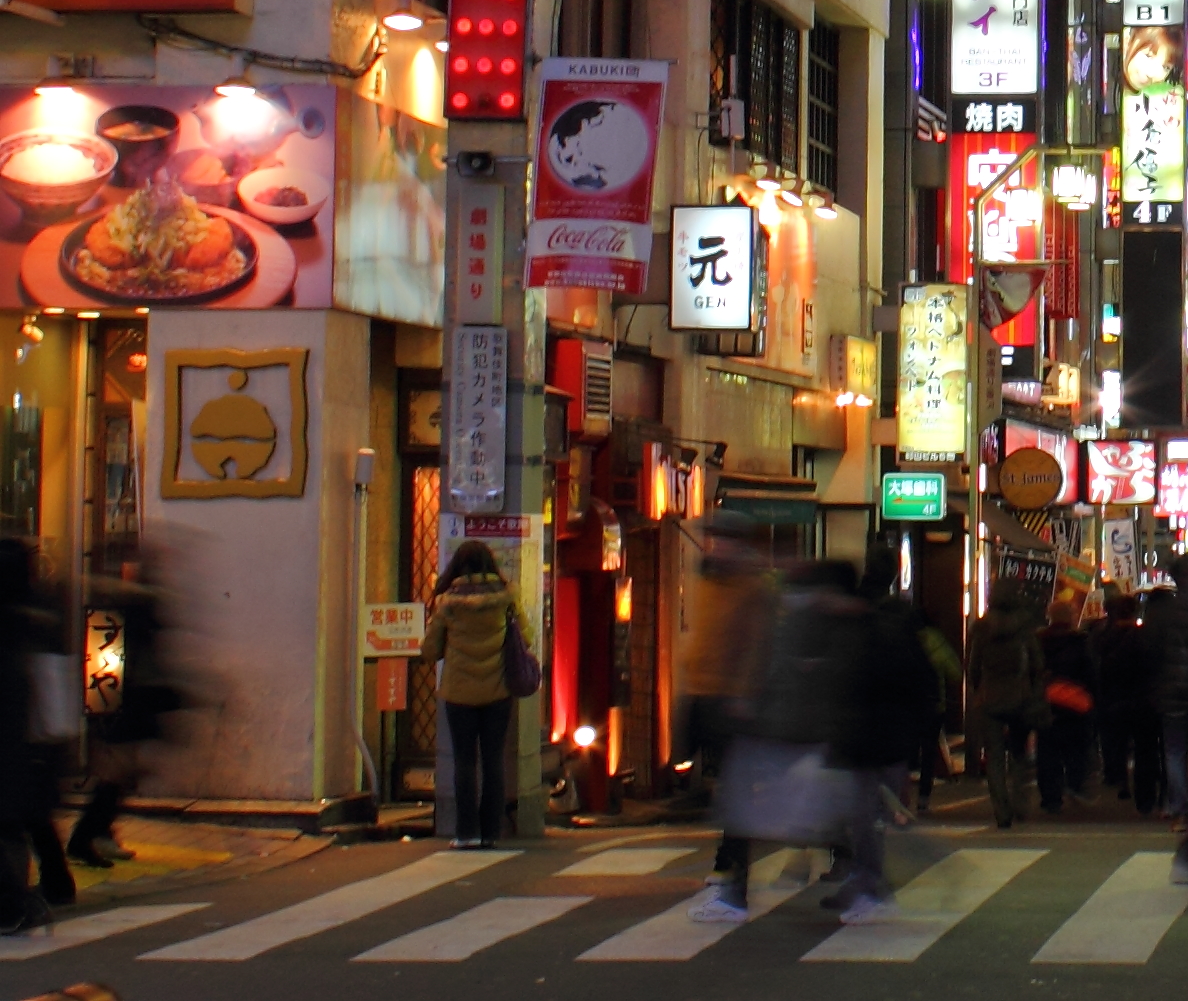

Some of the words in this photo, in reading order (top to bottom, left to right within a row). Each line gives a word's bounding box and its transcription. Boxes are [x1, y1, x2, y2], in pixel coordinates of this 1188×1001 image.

[1137, 4, 1170, 21] B1
[978, 71, 1009, 87] 3F
[966, 102, 1023, 132] 焼肉
[1133, 202, 1173, 223] 4F
[469, 207, 488, 299] 劇場通り
[689, 235, 733, 287] 元
[694, 295, 727, 309] GEN
[470, 333, 489, 486] 防犯カメラ作動中
[370, 607, 414, 626] 営業中
